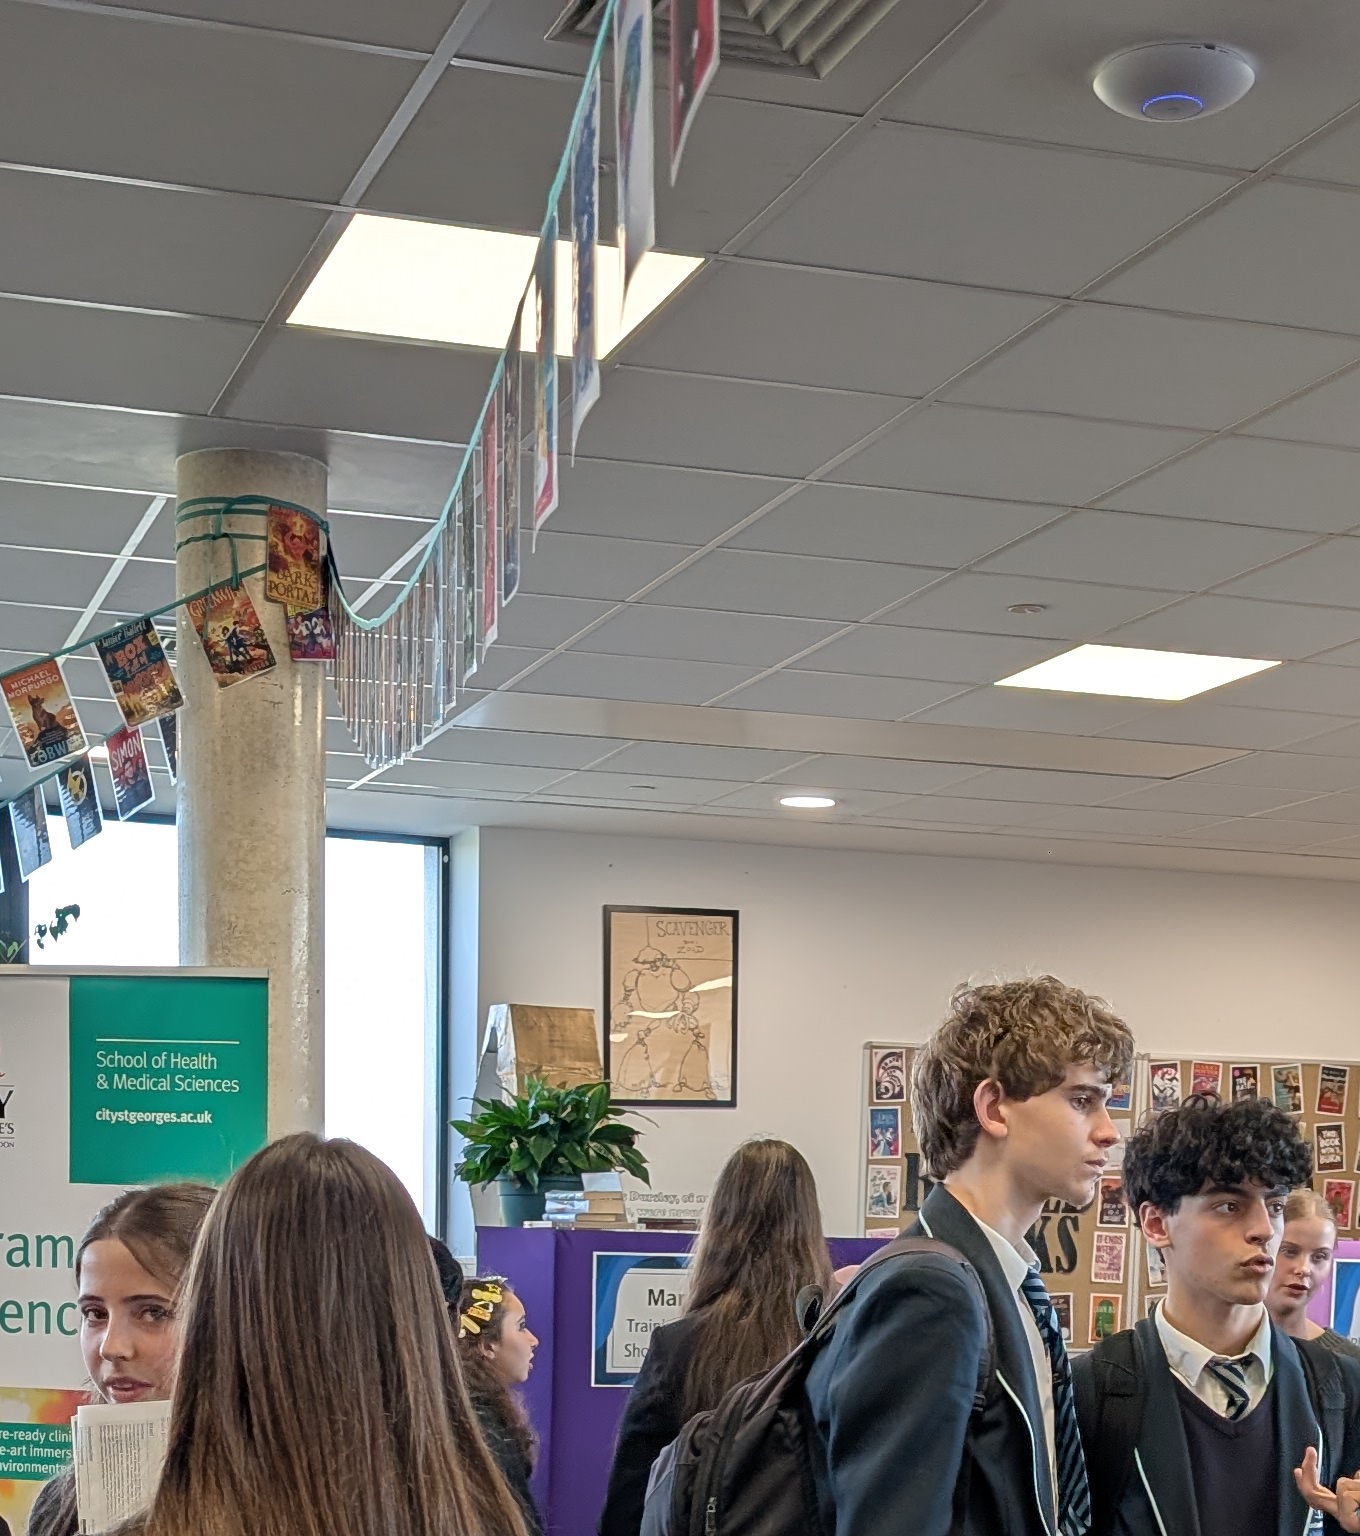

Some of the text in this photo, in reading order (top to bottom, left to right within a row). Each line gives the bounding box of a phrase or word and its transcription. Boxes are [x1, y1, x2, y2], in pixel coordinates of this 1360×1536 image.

[275, 568, 315, 590] DARK
[269, 583, 321, 606] PORTAL
[114, 636, 146, 668] BOX
[7, 675, 60, 698] MORPURGO
[11, 670, 51, 690] MICHAEL
[111, 733, 143, 771] SIMON
[655, 919, 730, 938] SCAVENGER
[96, 1051, 217, 1070] School of Health
[96, 1073, 240, 1092] & Medical Sciences
[95, 1108, 213, 1127] citystgeorges.ac.uk
[48, 1430, 72, 1442] clini
[30, 1445, 72, 1459] immers
